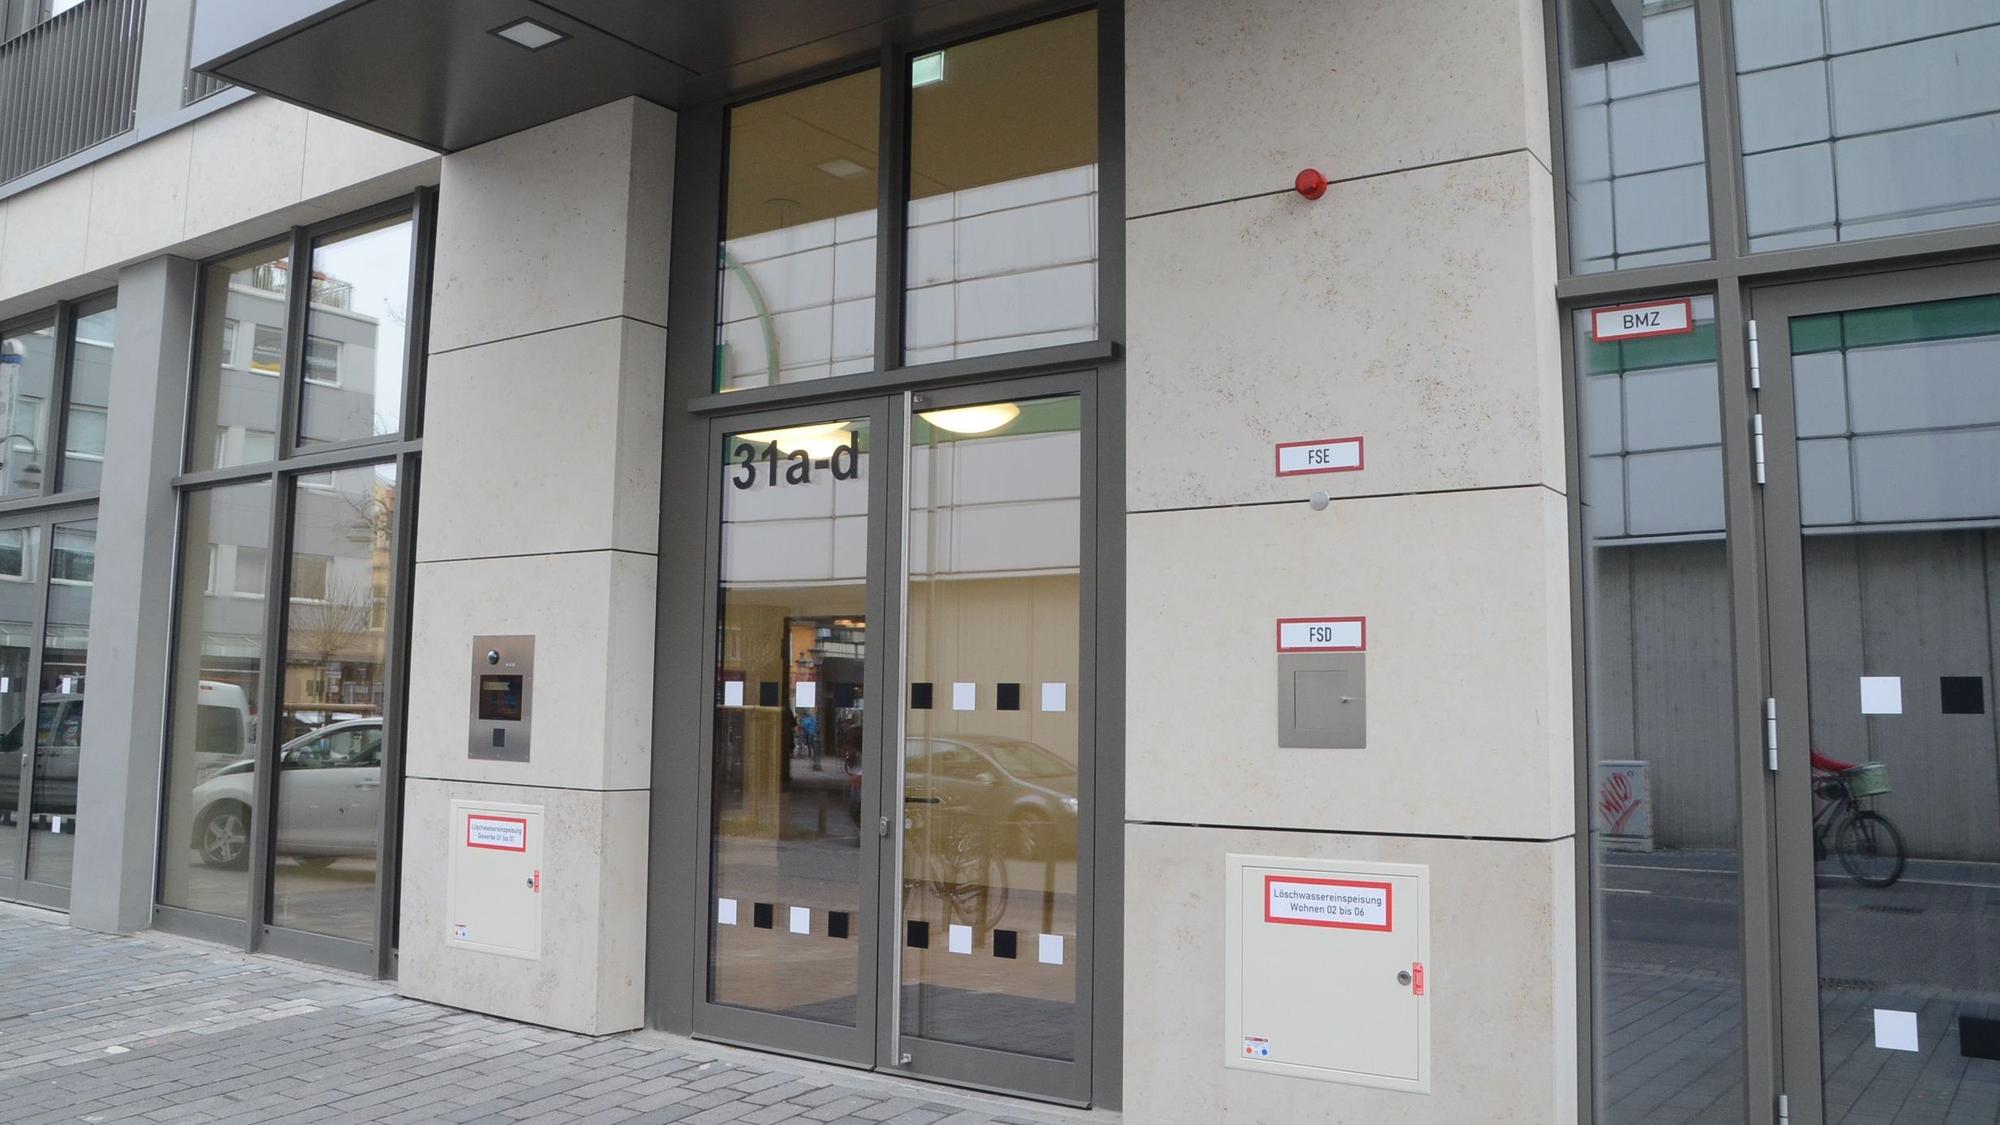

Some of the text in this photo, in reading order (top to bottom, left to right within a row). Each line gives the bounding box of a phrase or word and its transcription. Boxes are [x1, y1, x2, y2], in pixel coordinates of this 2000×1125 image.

[1623, 311, 1661, 330] BMZ
[733, 430, 859, 490] 31a-d
[1308, 448, 1330, 465] FSE
[1309, 626, 1332, 643] FSD
[1273, 888, 1382, 907] Löschwassereinspeisung
[1290, 902, 1365, 917] Wohnen 02 bis 06
